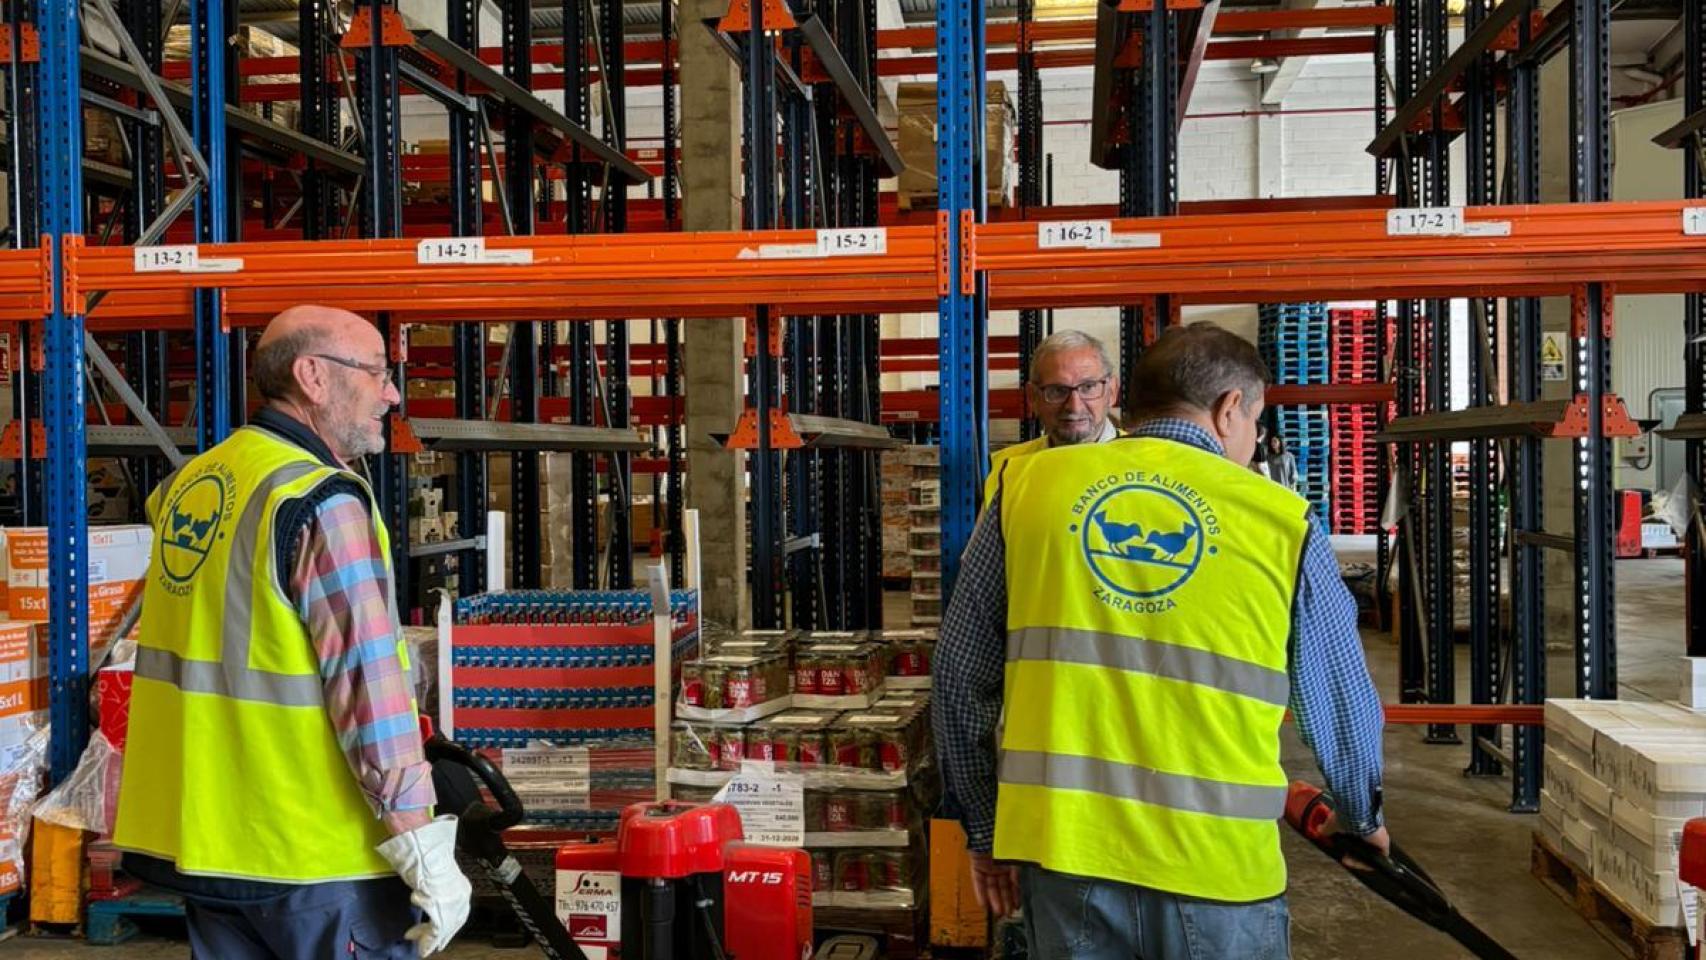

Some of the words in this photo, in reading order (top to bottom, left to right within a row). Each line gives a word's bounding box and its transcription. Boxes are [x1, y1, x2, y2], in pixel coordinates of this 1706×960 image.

[1410, 213, 1444, 228] 17-2
[1061, 226, 1093, 240] 16-2
[836, 233, 867, 248] 15-2
[438, 243, 467, 257] 14-2
[154, 251, 182, 265] 13-2
[1072, 474, 1119, 515] BANCO
[1124, 471, 1146, 482] DE
[1151, 473, 1221, 536] ALIMENTOS
[20, 597, 47, 610] 15x1
[1092, 585, 1177, 614] ZARAGOZA
[821, 669, 840, 677] DAN
[728, 870, 760, 884] MT
[761, 872, 784, 884] 15
